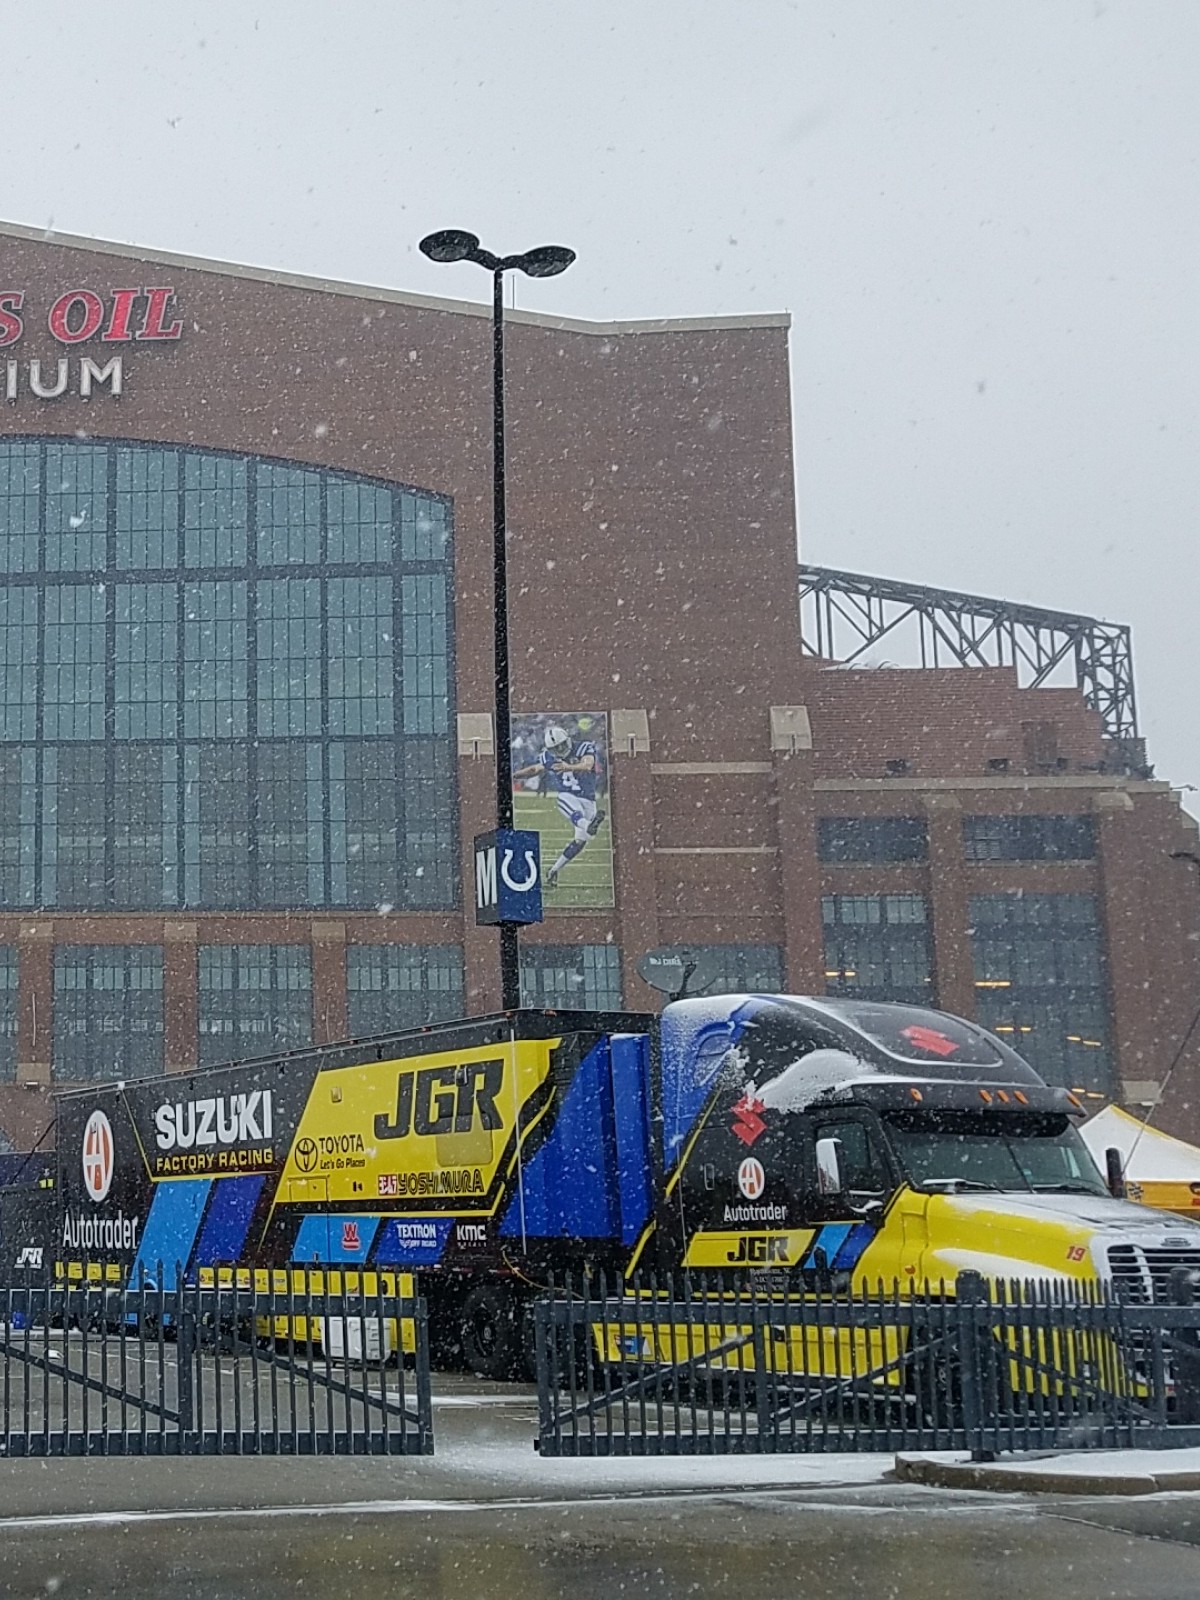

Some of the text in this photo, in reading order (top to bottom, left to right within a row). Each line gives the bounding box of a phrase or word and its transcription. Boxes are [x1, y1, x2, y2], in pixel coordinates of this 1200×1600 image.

[48, 286, 185, 344] OIL
[561, 771, 582, 791] 4
[476, 847, 498, 909] M
[374, 1058, 505, 1141] JGR
[155, 1089, 273, 1150] SUZUKI
[318, 1133, 365, 1154] TOYOTA
[156, 1148, 273, 1172] FACTORY RACING
[336, 1158, 345, 1169] Go
[397, 1168, 485, 1196] YOSHIMURA
[723, 1202, 787, 1222] Autotrader
[62, 1210, 138, 1250] Autotrader
[396, 1223, 437, 1239] TEXTRON
[456, 1224, 488, 1241] KMC
[727, 1236, 790, 1262] JGR
[1066, 1245, 1086, 1262] 19
